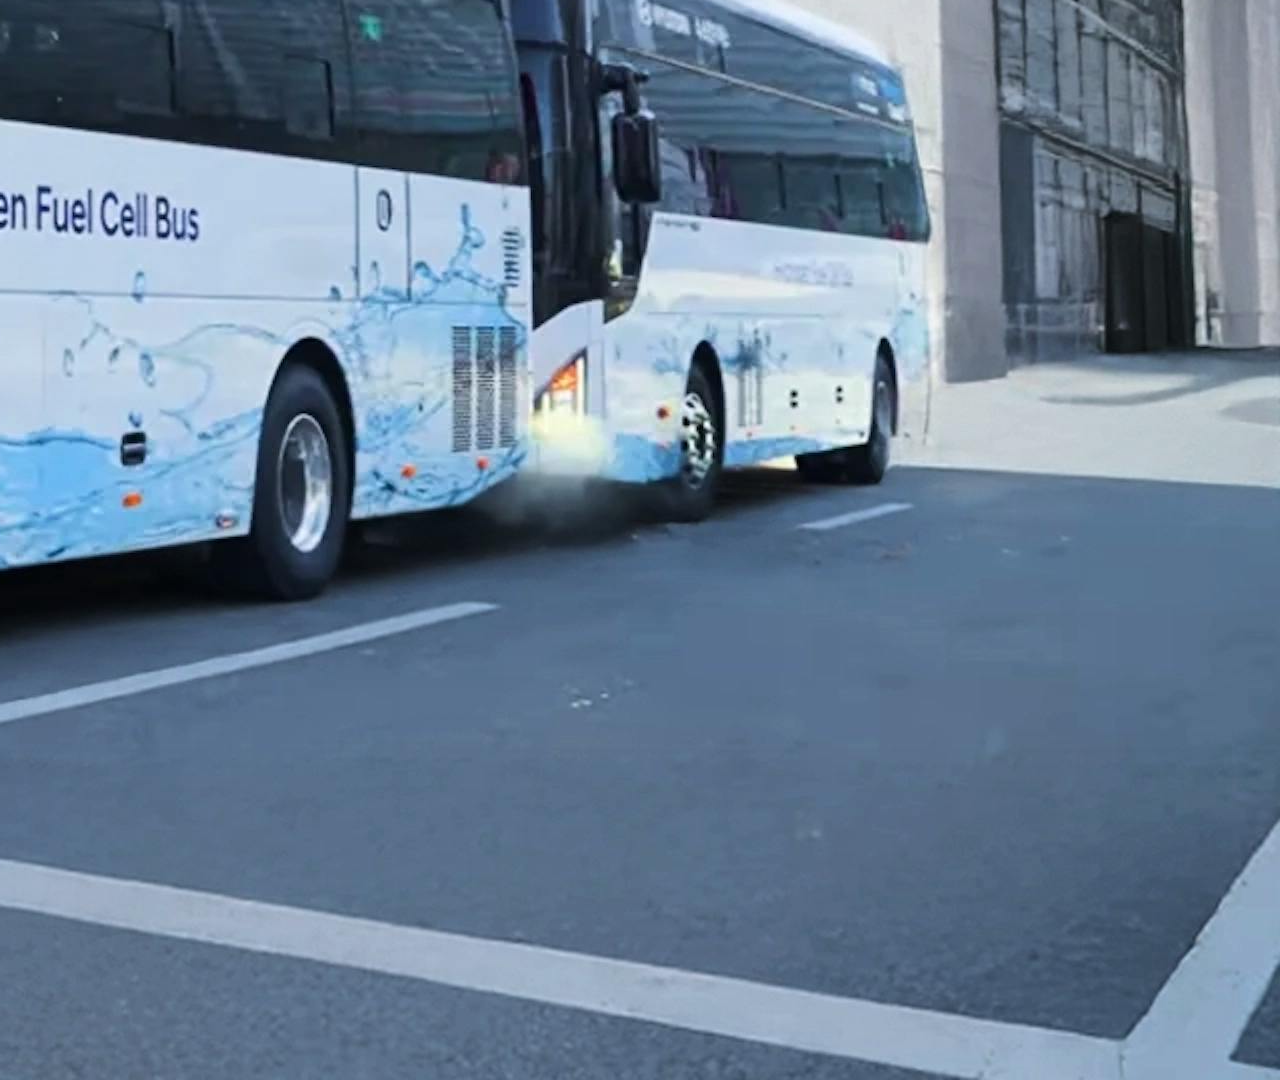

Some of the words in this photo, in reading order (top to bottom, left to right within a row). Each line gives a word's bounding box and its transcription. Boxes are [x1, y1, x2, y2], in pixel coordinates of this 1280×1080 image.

[36, 185, 93, 234] Fuel
[100, 191, 149, 237] Cell
[155, 196, 200, 241] Bus
